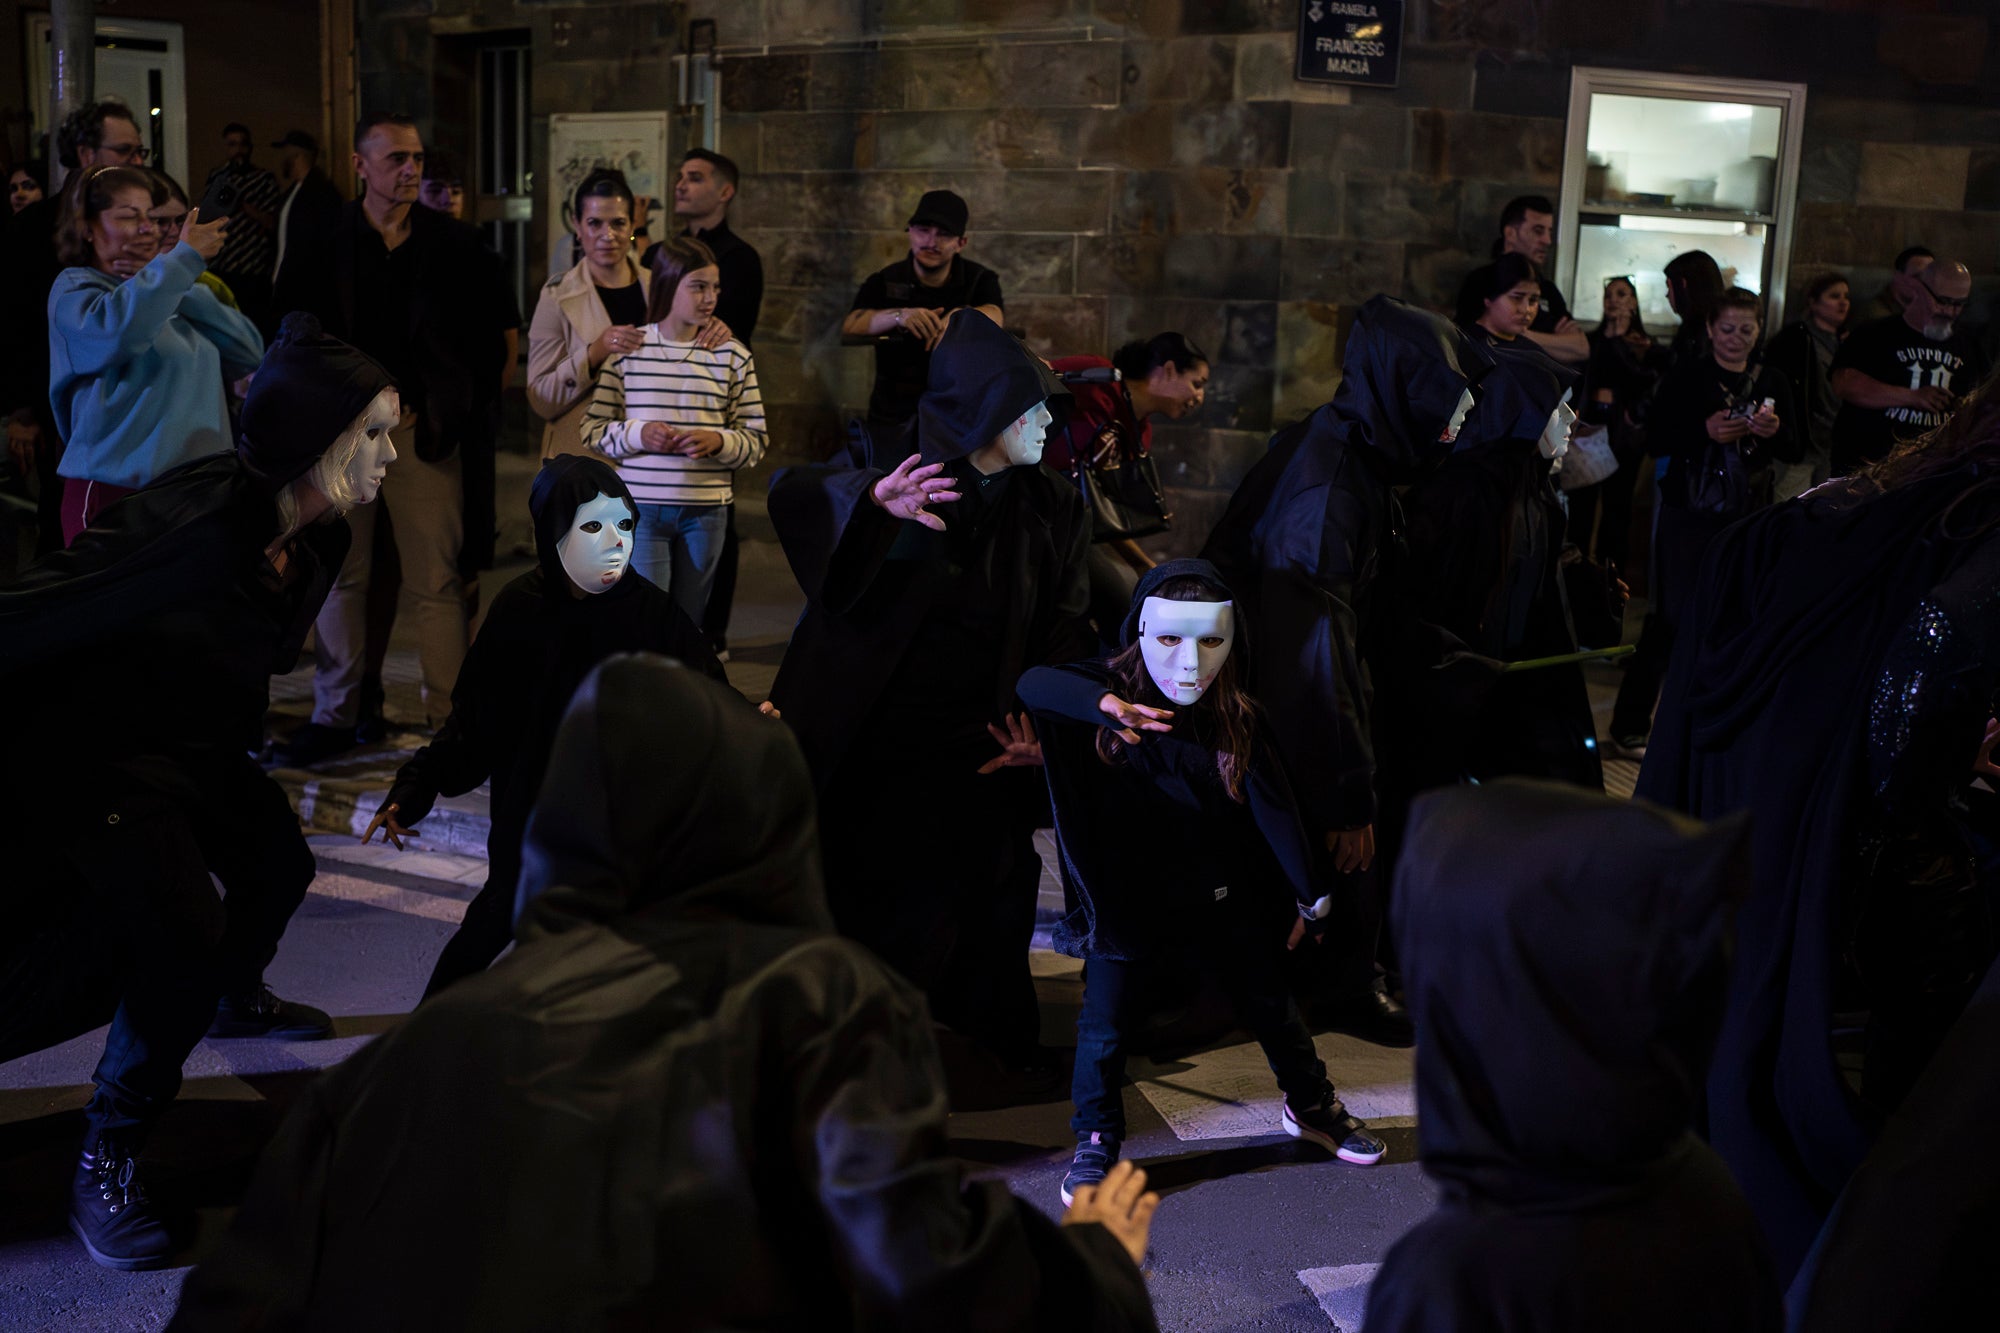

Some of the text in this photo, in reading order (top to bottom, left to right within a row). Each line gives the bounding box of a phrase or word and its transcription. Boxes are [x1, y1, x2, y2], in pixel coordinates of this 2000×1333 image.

[1331, 2, 1378, 18] RAMBLA
[1315, 36, 1385, 57] FRANCESC
[1326, 57, 1370, 75] MACIÀ
[1896, 346, 1964, 369] SUPPORT
